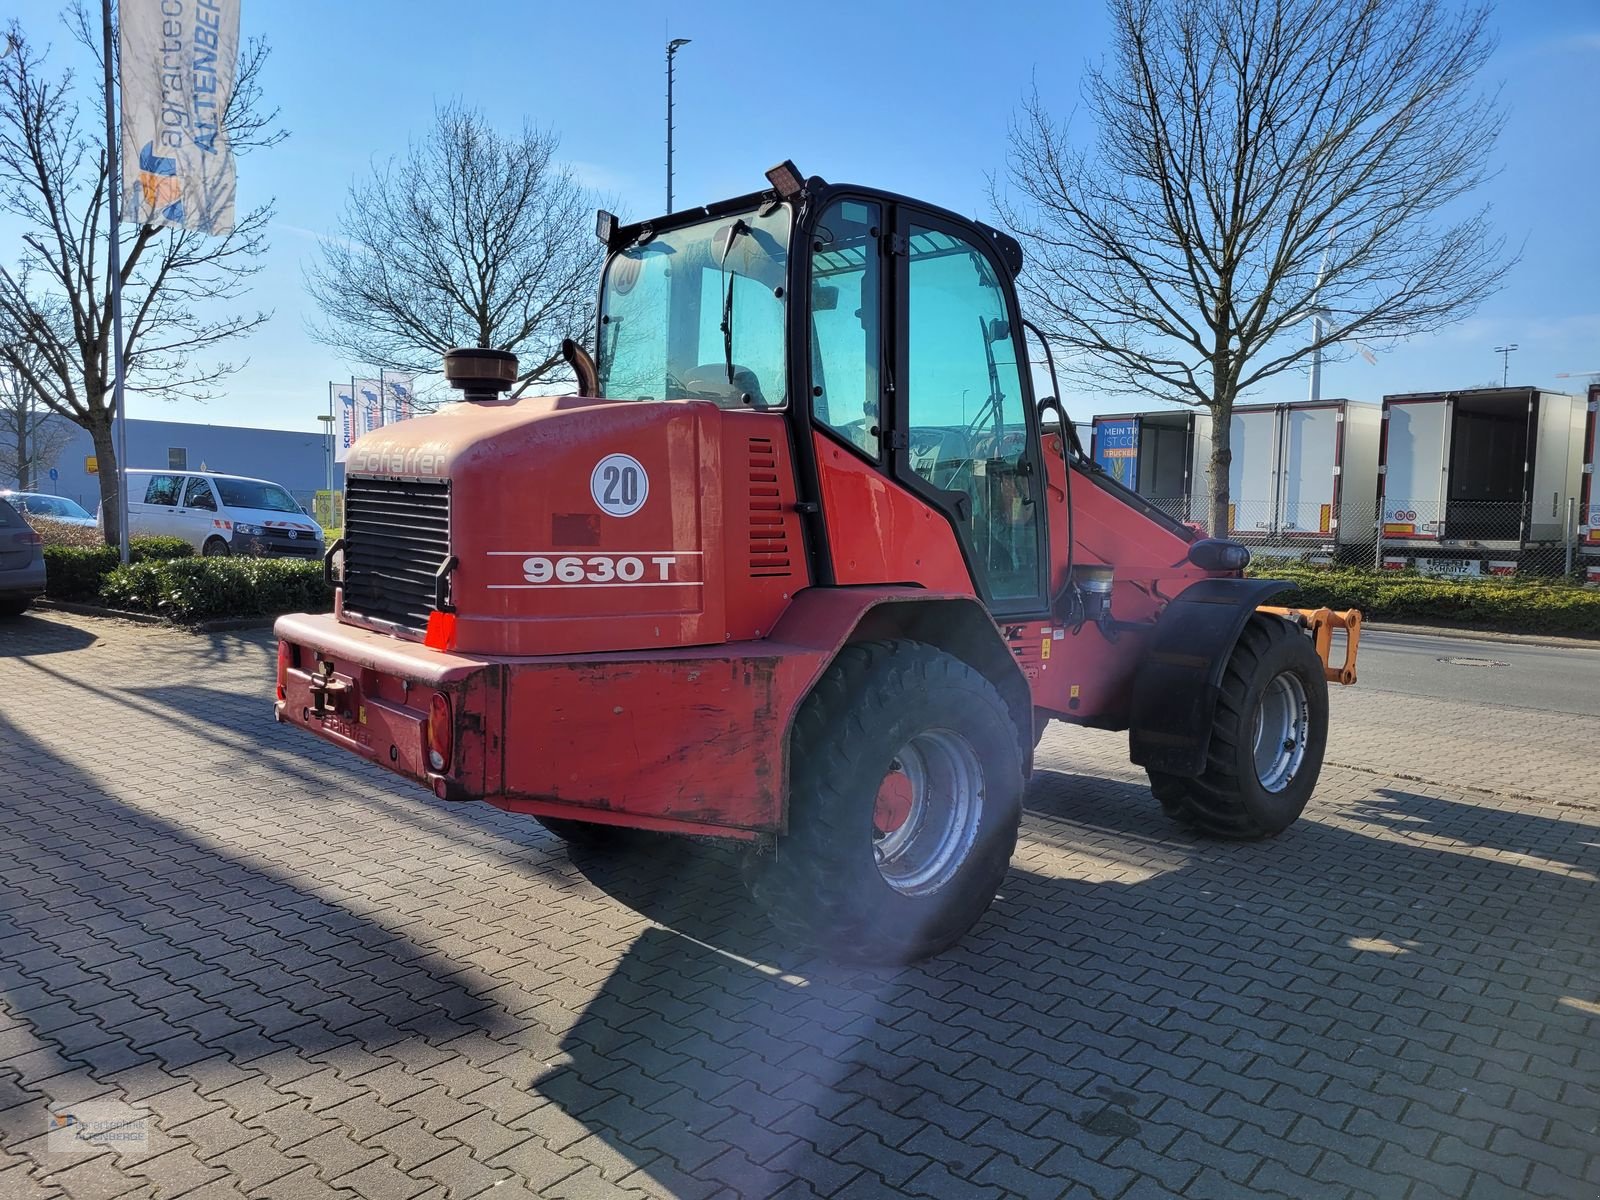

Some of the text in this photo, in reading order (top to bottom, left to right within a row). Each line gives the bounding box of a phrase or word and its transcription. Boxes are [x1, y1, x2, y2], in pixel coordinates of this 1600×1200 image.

[1103, 436, 1118, 447] IST
[1104, 427, 1125, 436] MEIN
[350, 446, 446, 474] Schäffer
[603, 466, 638, 505] 20
[522, 557, 676, 583] 9630 T
